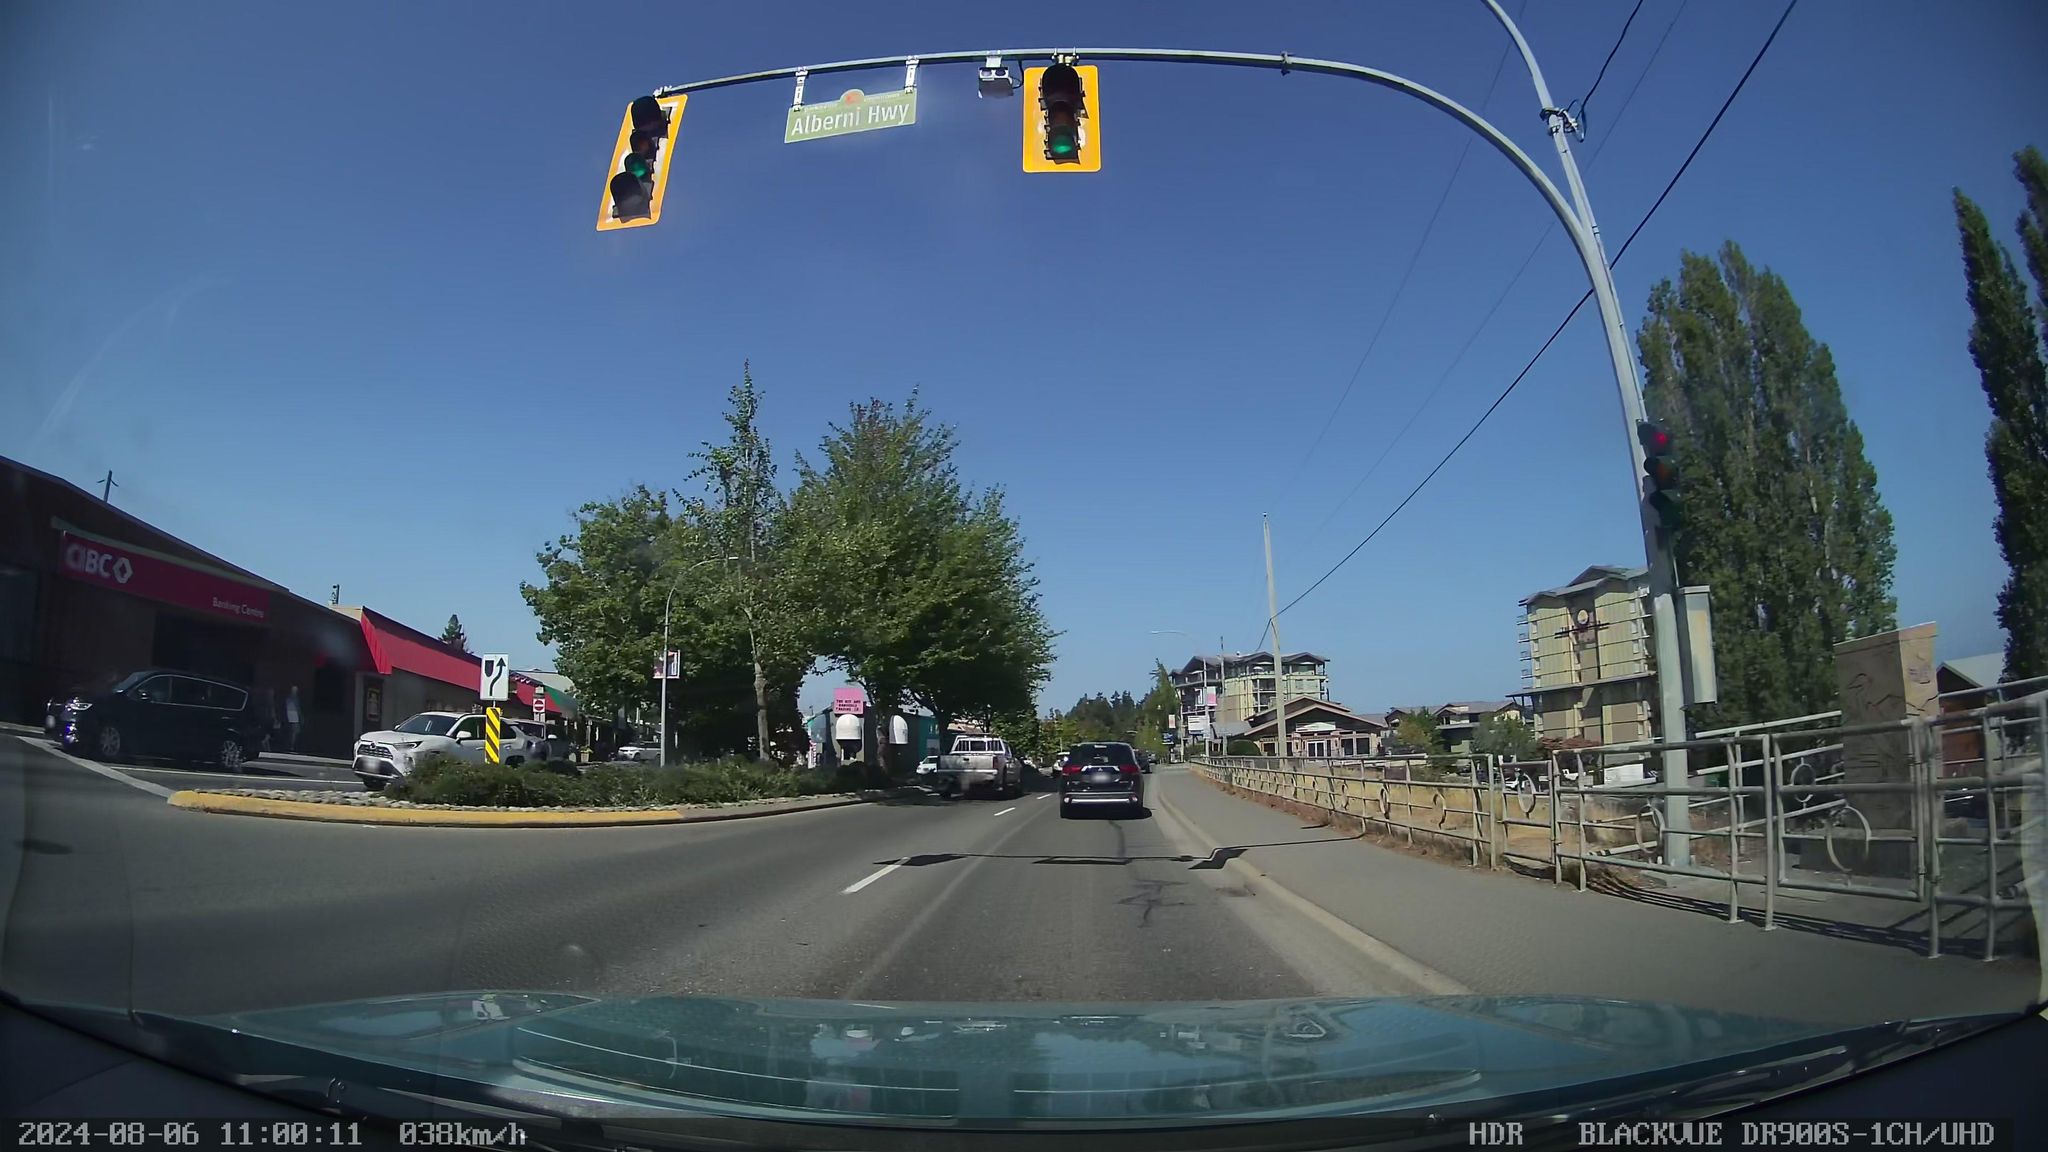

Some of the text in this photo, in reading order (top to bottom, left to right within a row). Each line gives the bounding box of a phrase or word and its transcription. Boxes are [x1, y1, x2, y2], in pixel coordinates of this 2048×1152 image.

[791, 103, 910, 136] Alberni Hwy
[65, 543, 113, 578] CIBC
[212, 596, 264, 618] Banking Centre
